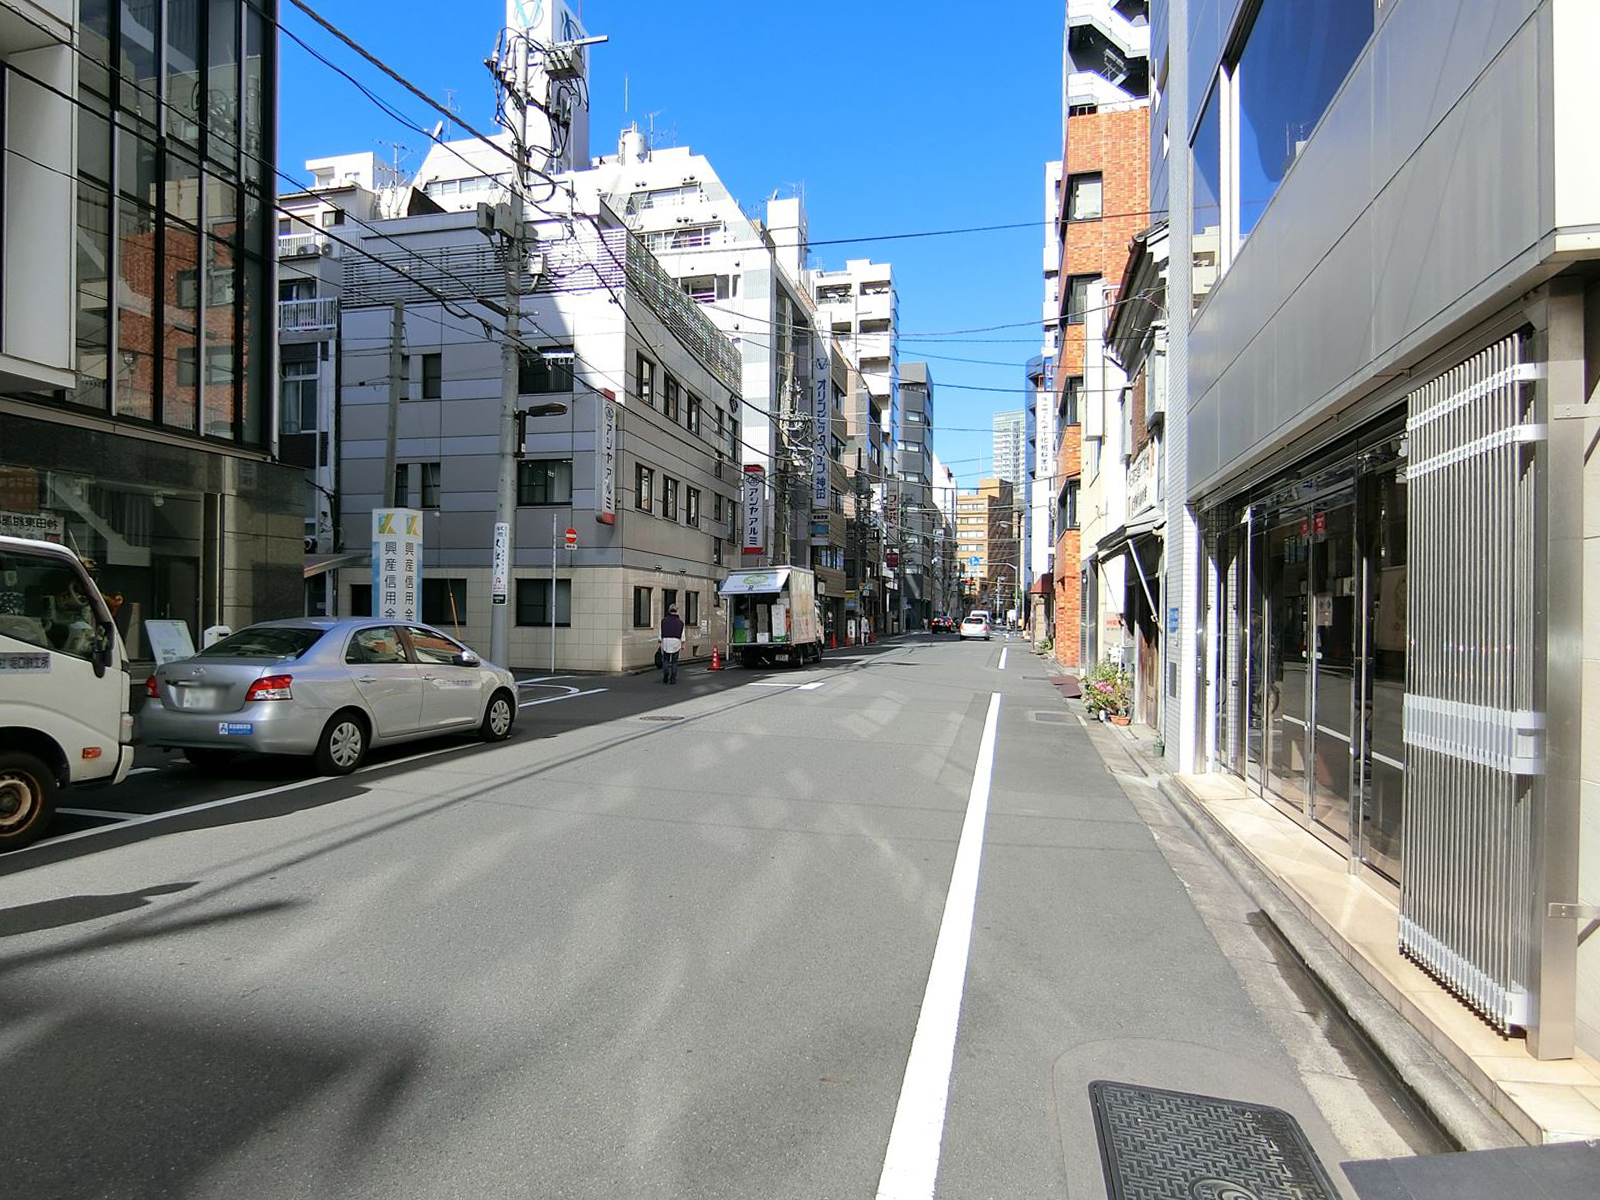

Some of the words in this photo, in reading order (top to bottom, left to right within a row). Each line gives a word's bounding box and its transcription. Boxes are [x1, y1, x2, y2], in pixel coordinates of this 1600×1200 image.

[748, 487, 759, 546] アシヤアルミ
[384, 541, 397, 619] 興産信用金
